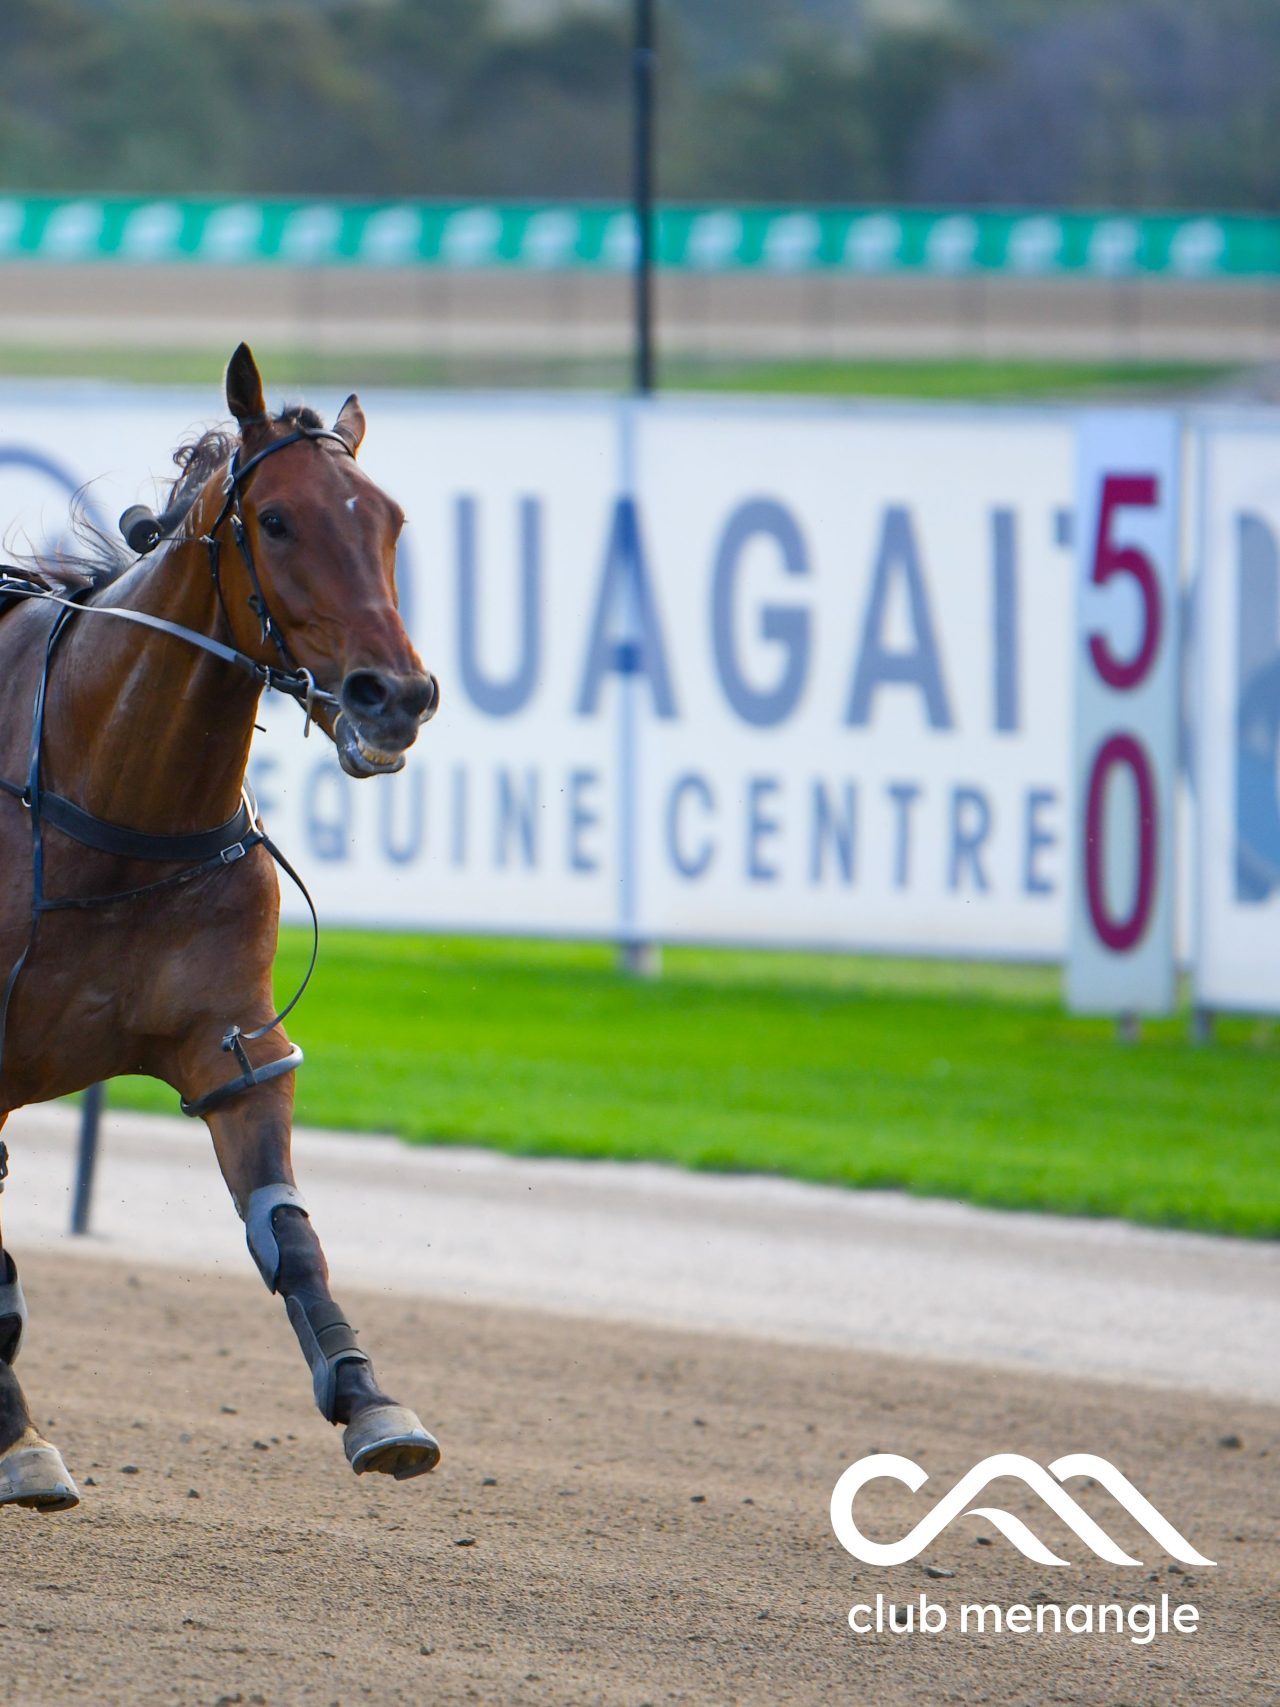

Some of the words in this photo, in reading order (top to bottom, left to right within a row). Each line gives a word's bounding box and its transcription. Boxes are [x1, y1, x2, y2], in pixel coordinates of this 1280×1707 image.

[392, 493, 1072, 735] UAGAI
[1086, 473, 1165, 955] 50
[665, 770, 1058, 896] CENTRE
